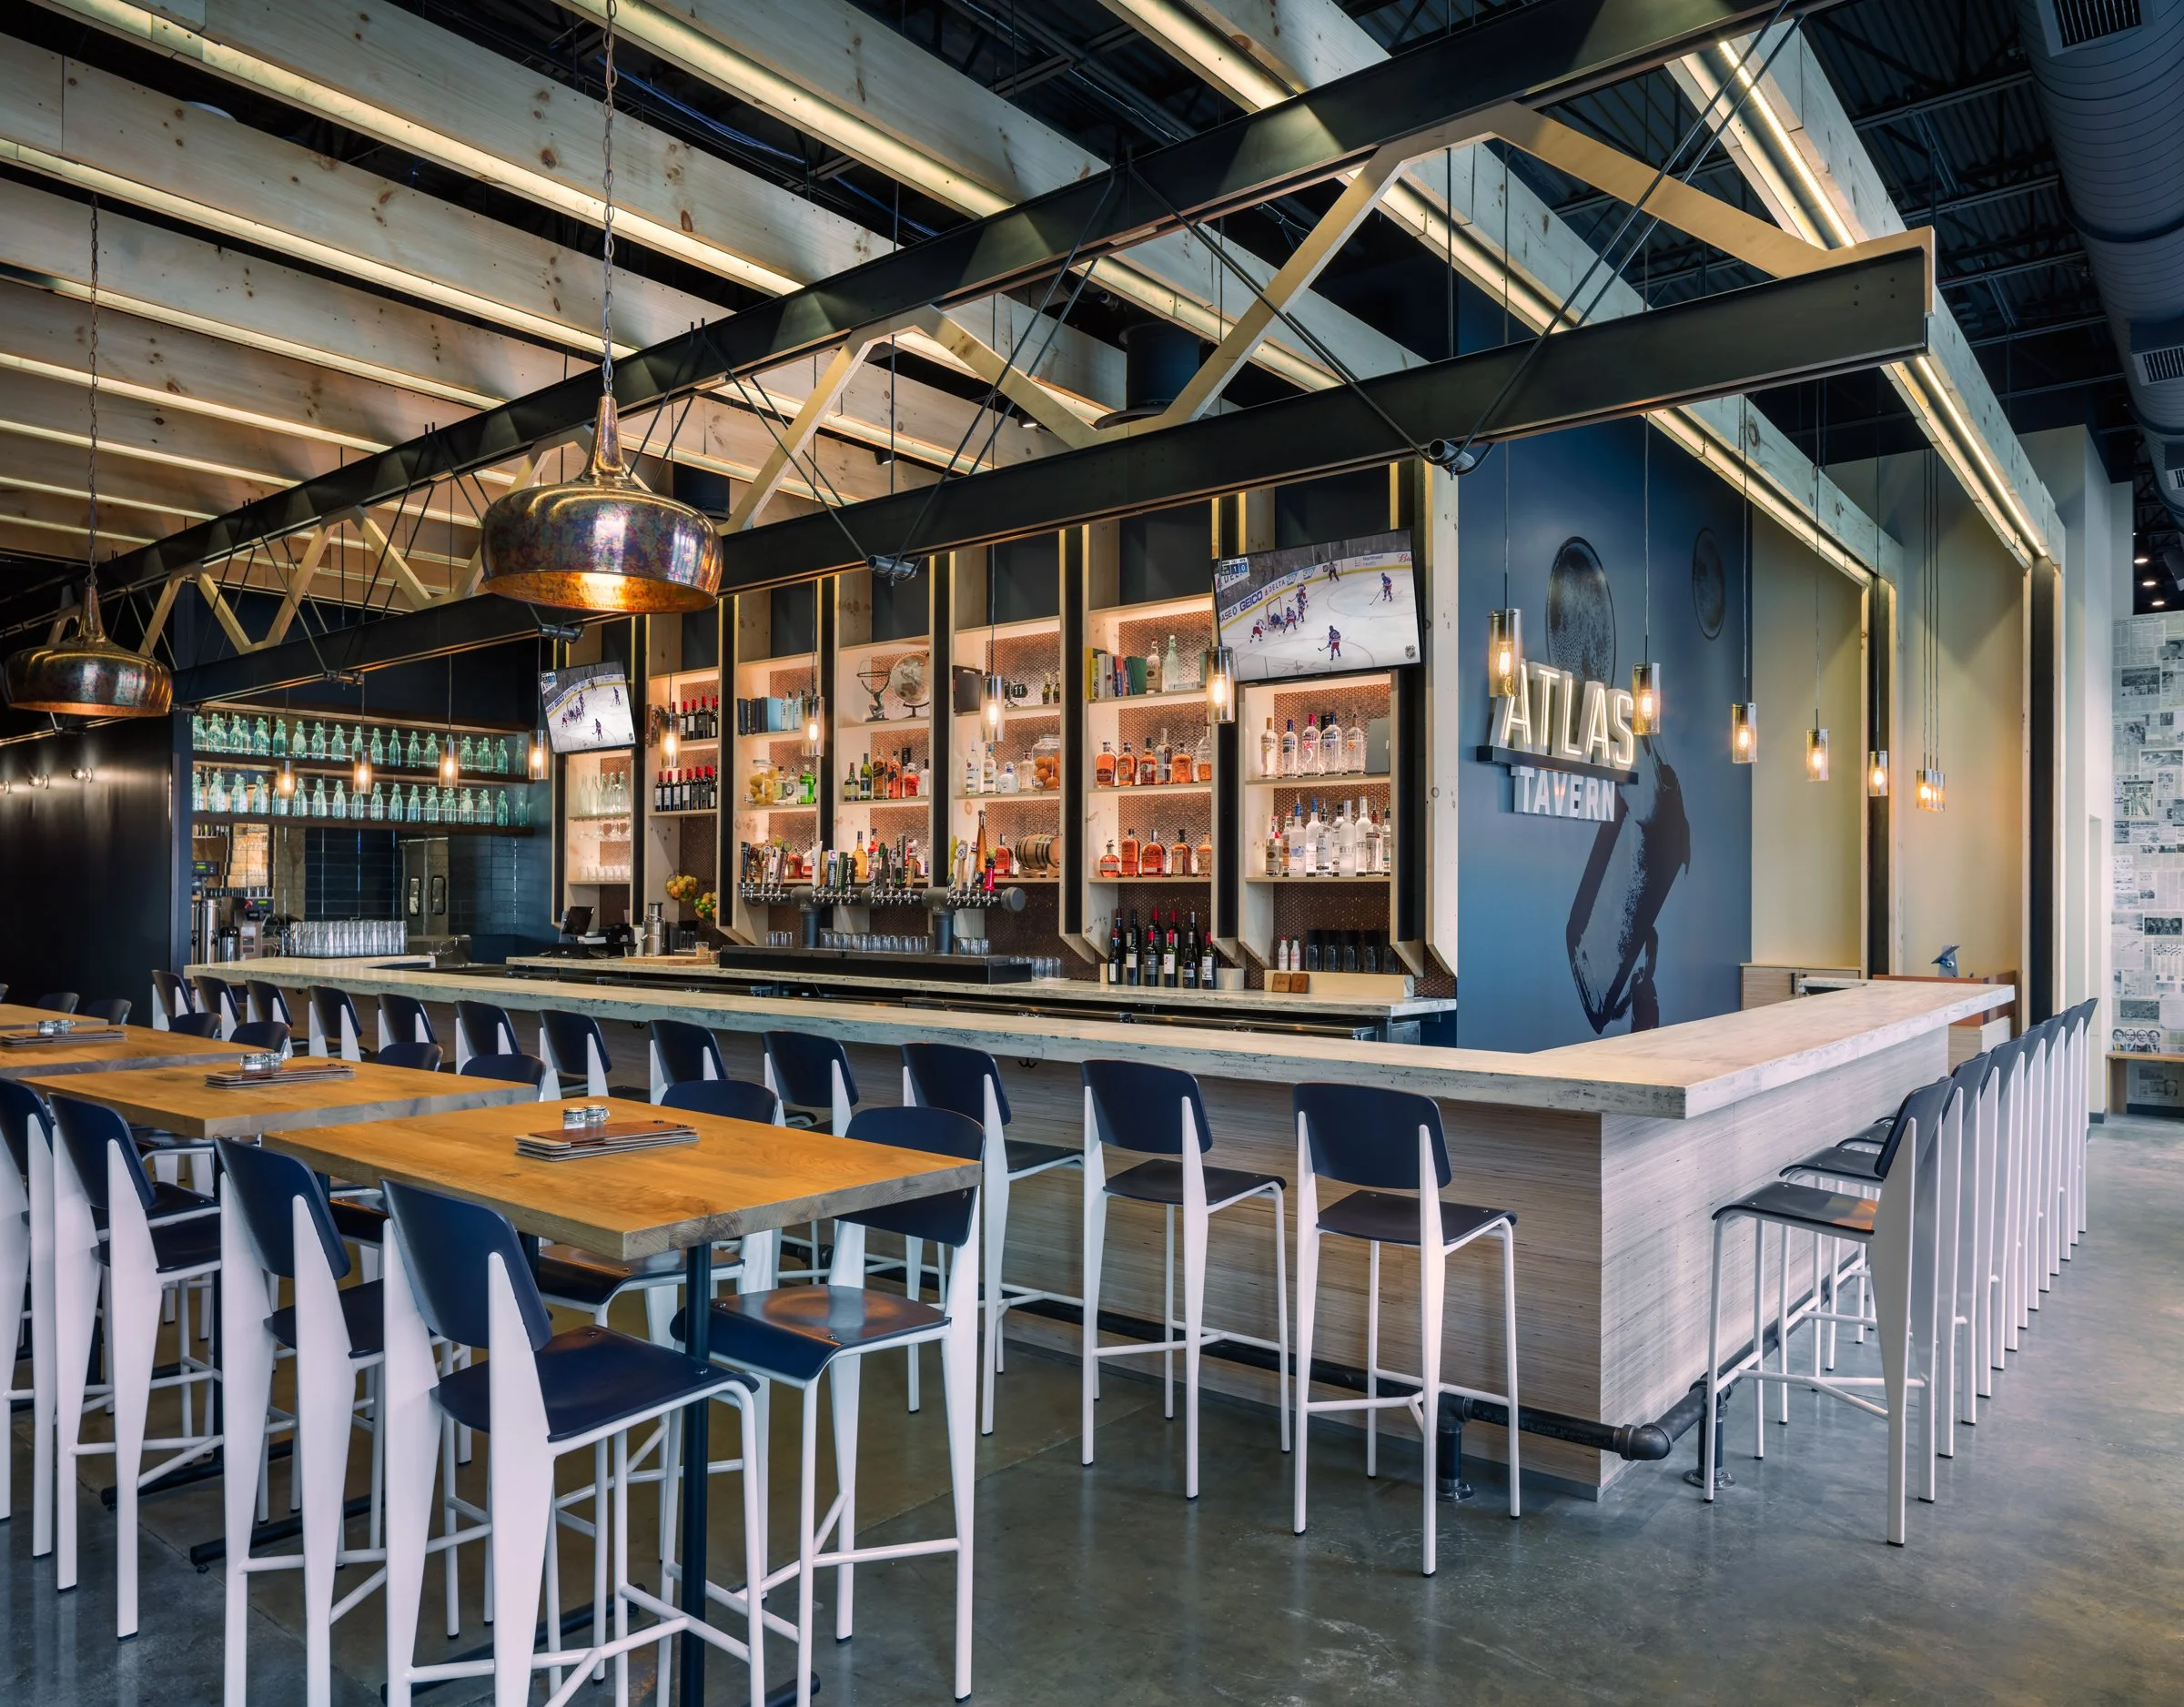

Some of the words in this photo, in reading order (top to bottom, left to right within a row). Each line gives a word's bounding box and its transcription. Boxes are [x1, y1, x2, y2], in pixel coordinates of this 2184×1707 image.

[1239, 591, 1263, 612] GEICO
[1269, 579, 1286, 593] DELTA
[1287, 574, 1297, 583] SAP
[1303, 569, 1314, 577] SAP
[1014, 685, 1023, 695] 11
[1490, 658, 1634, 771] ATLAS
[1511, 765, 1615, 822] TAVERN
